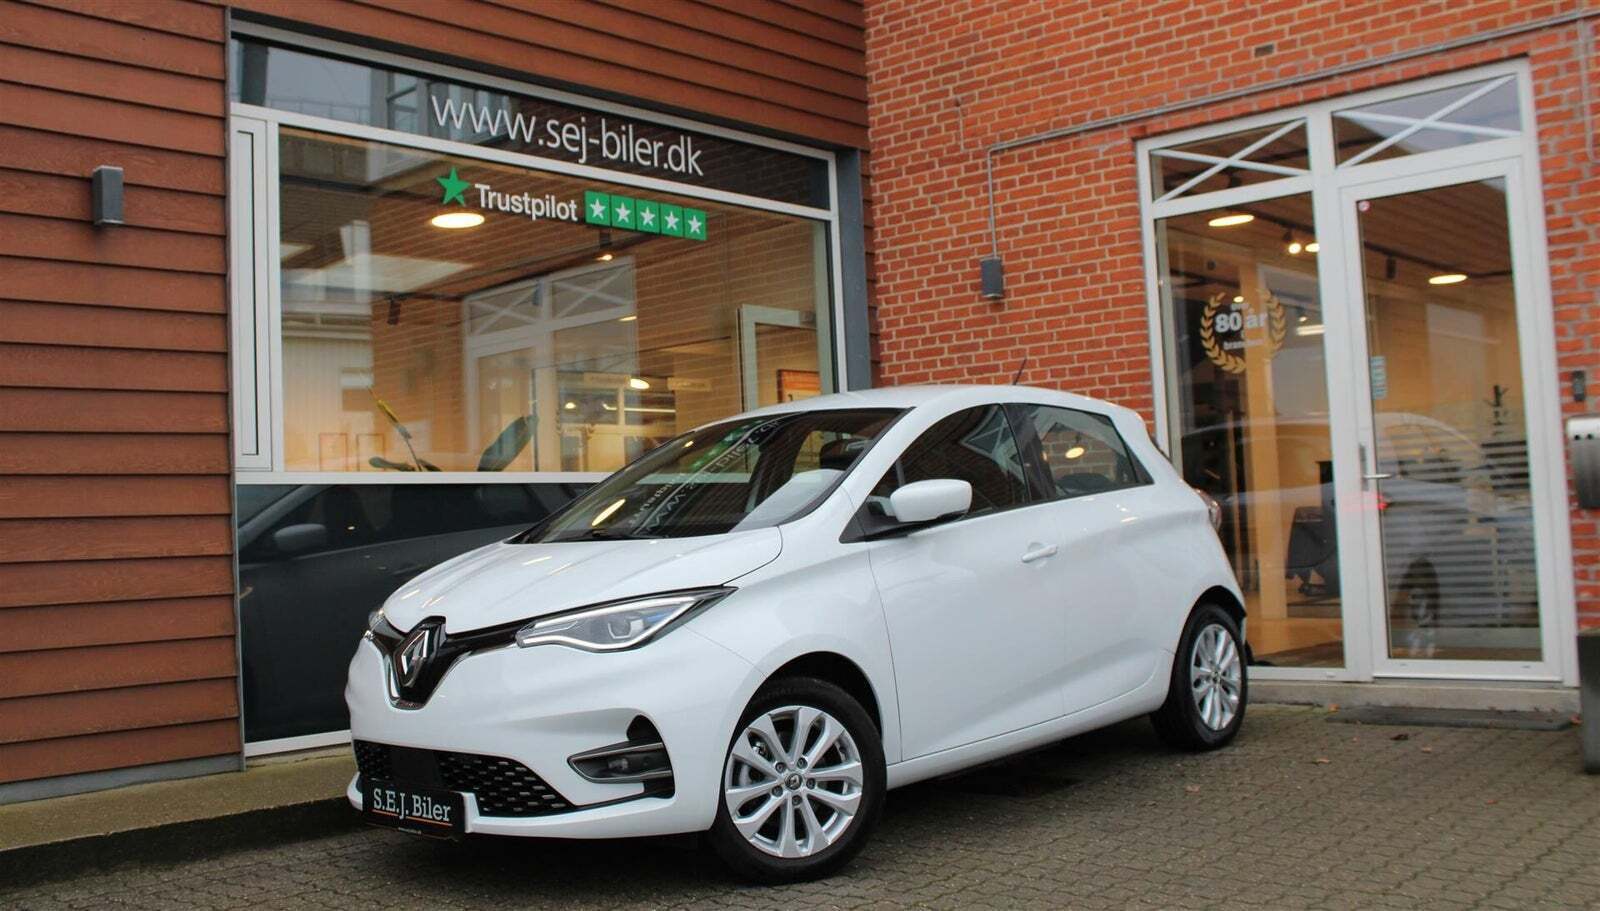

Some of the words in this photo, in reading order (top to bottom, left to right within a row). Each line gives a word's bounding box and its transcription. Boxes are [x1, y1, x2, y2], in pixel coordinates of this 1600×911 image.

[431, 95, 704, 176] www.sej-biler.dk
[474, 183, 578, 222] Trustpilot
[1215, 312, 1242, 333] 80
[373, 788, 409, 819] S.E.J.
[412, 794, 451, 821] Biler
